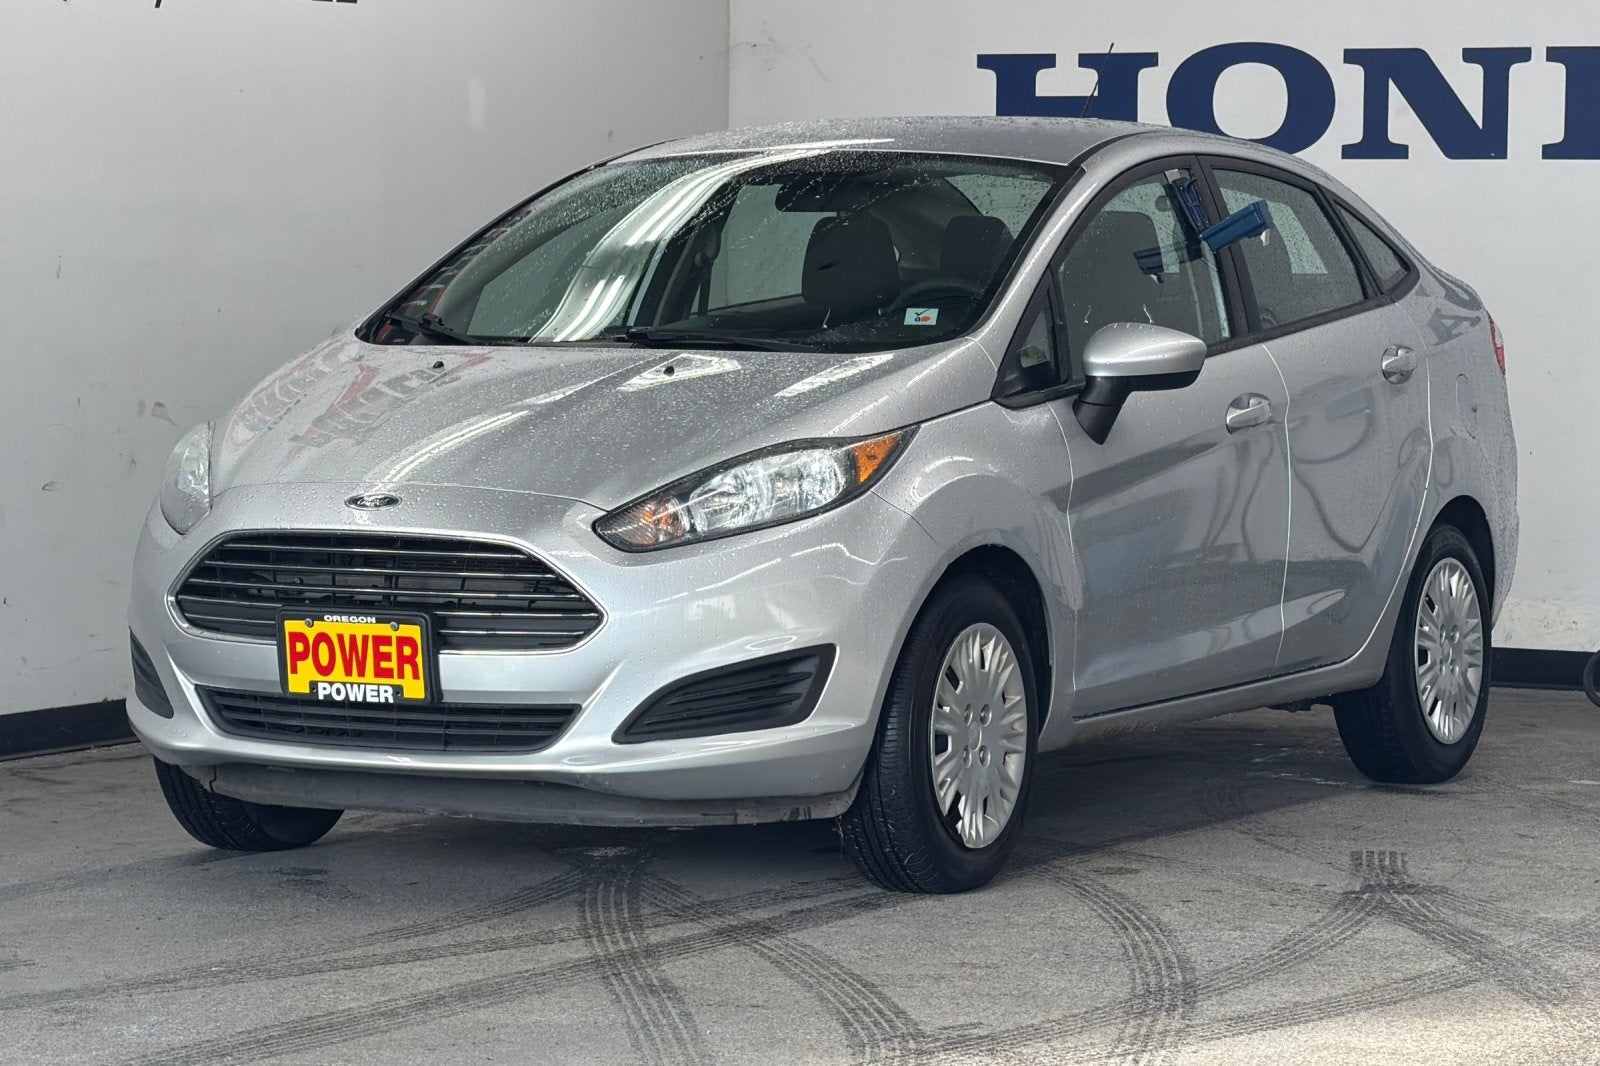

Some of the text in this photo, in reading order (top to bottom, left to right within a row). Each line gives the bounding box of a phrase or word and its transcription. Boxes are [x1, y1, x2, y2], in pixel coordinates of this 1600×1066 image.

[323, 615, 376, 624] OREGON
[288, 631, 420, 680] POWER
[317, 682, 394, 703] POWER
